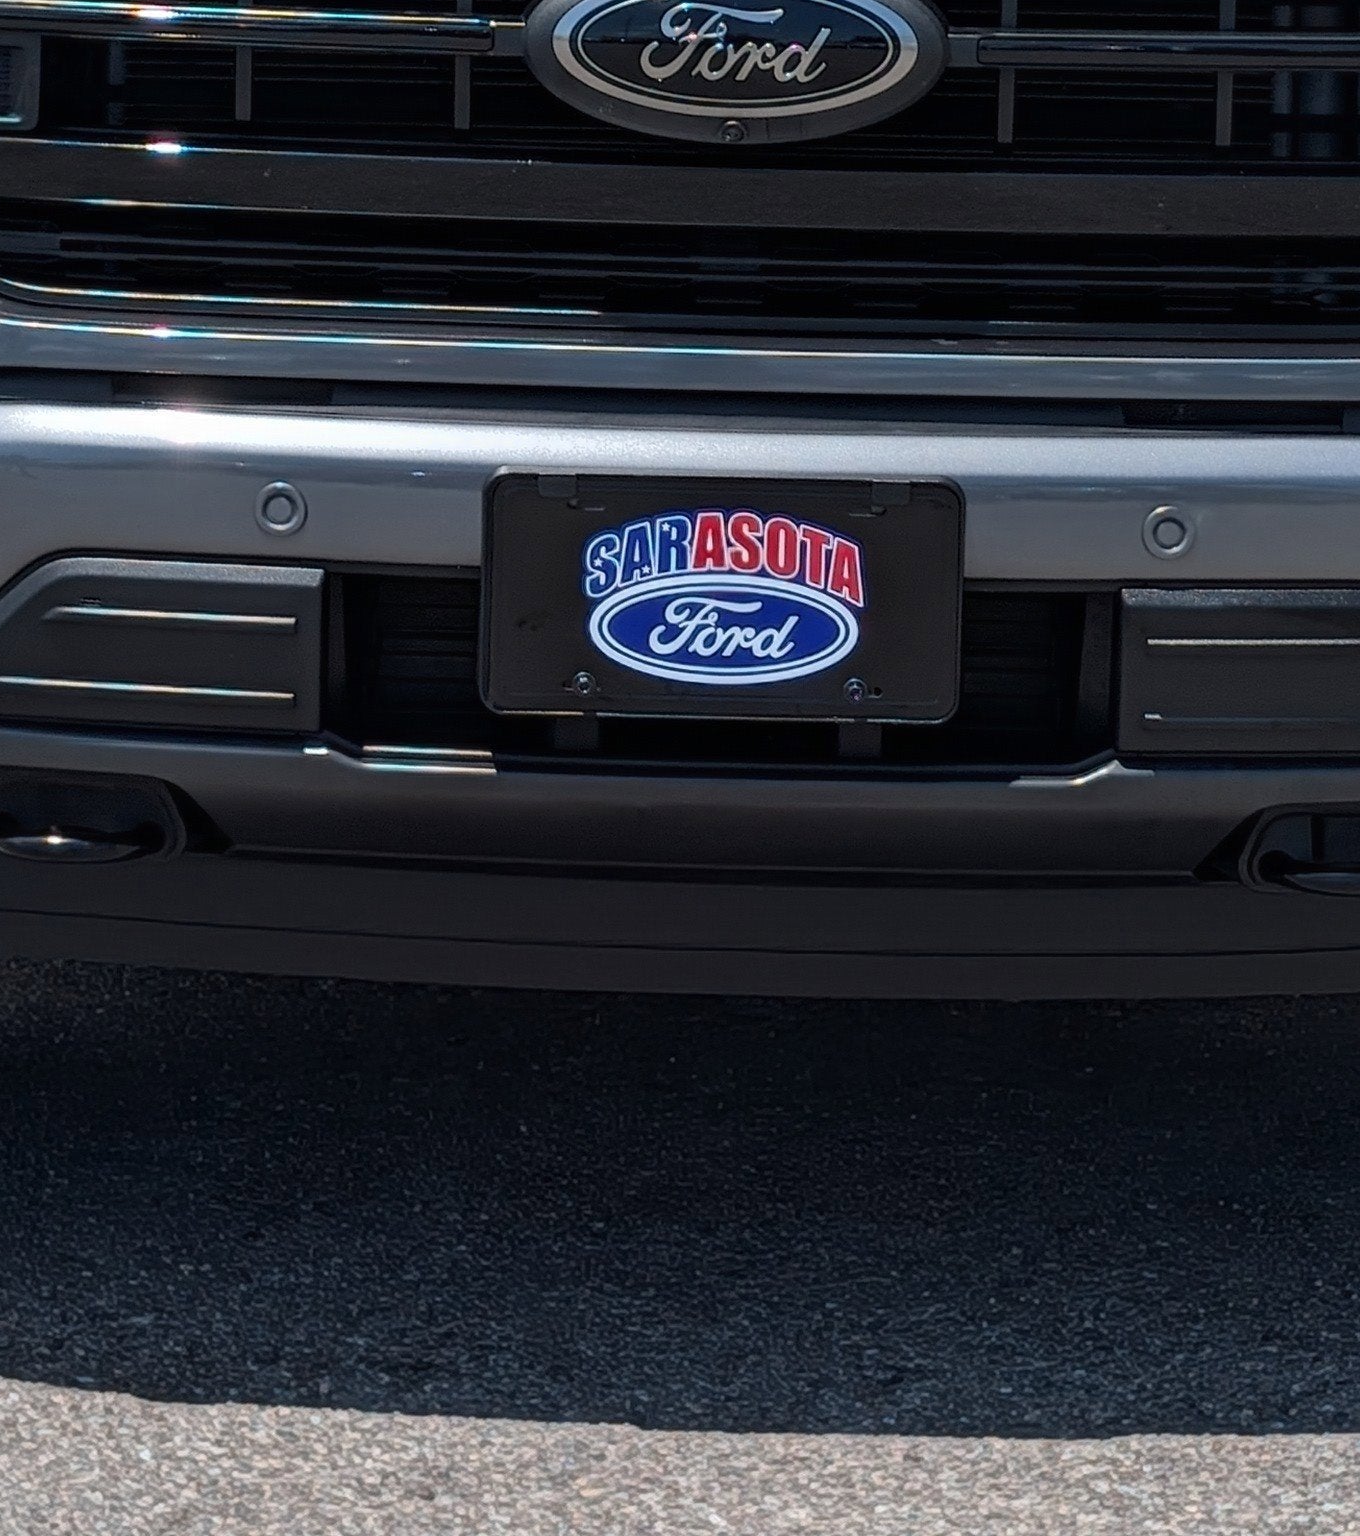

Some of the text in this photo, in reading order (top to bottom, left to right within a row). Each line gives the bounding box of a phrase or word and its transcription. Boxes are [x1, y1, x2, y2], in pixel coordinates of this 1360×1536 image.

[640, 2, 833, 84] Ford
[584, 509, 866, 609] SARASOTA
[648, 596, 800, 659] Ford
